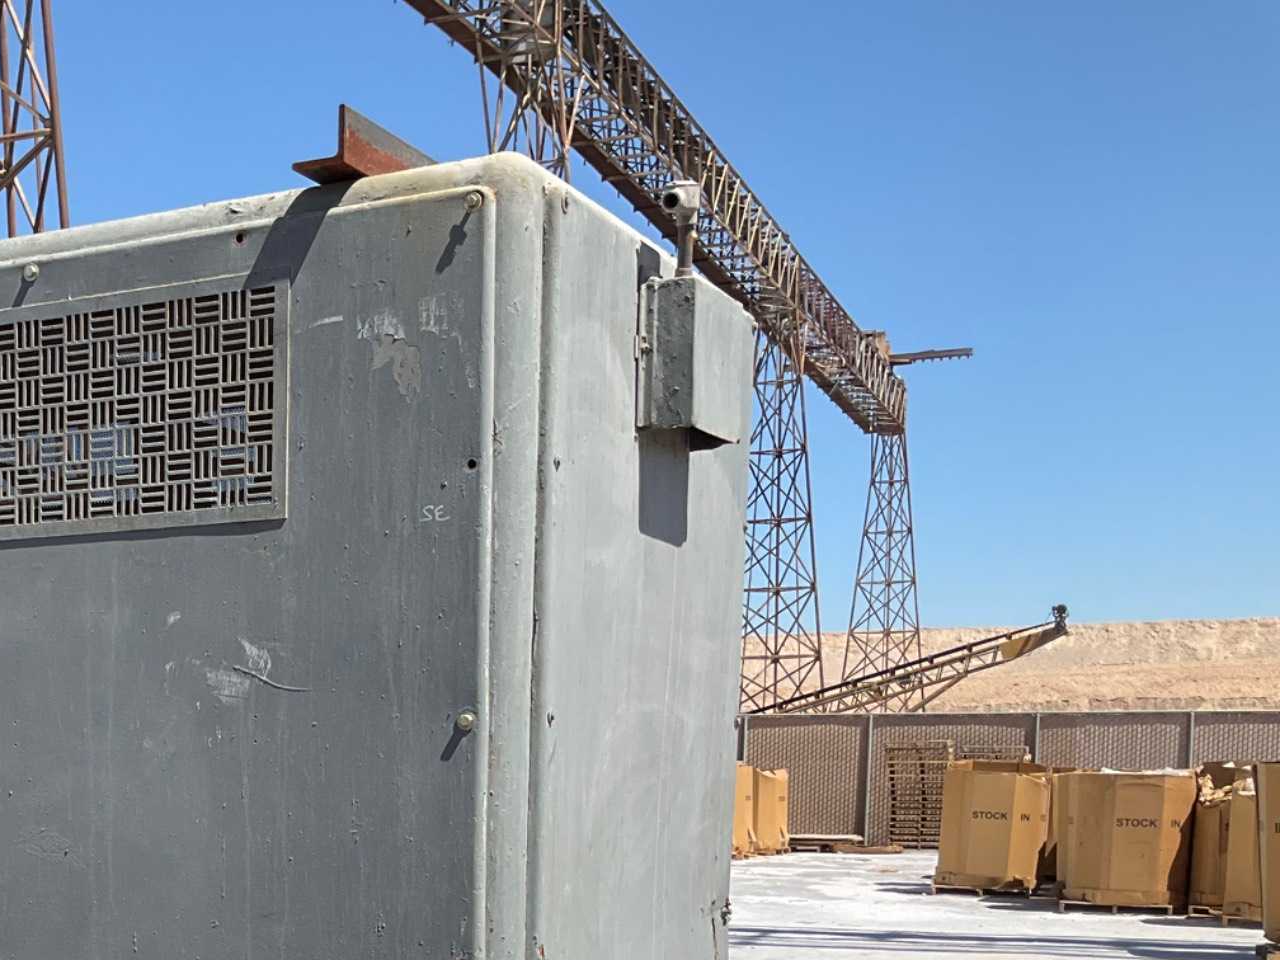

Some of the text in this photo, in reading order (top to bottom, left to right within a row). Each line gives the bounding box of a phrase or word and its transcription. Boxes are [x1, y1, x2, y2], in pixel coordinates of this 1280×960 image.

[420, 504, 450, 521] SE
[971, 810, 1008, 821] STOCK
[1020, 813, 1031, 823] IN
[1115, 817, 1158, 829] STOCK
